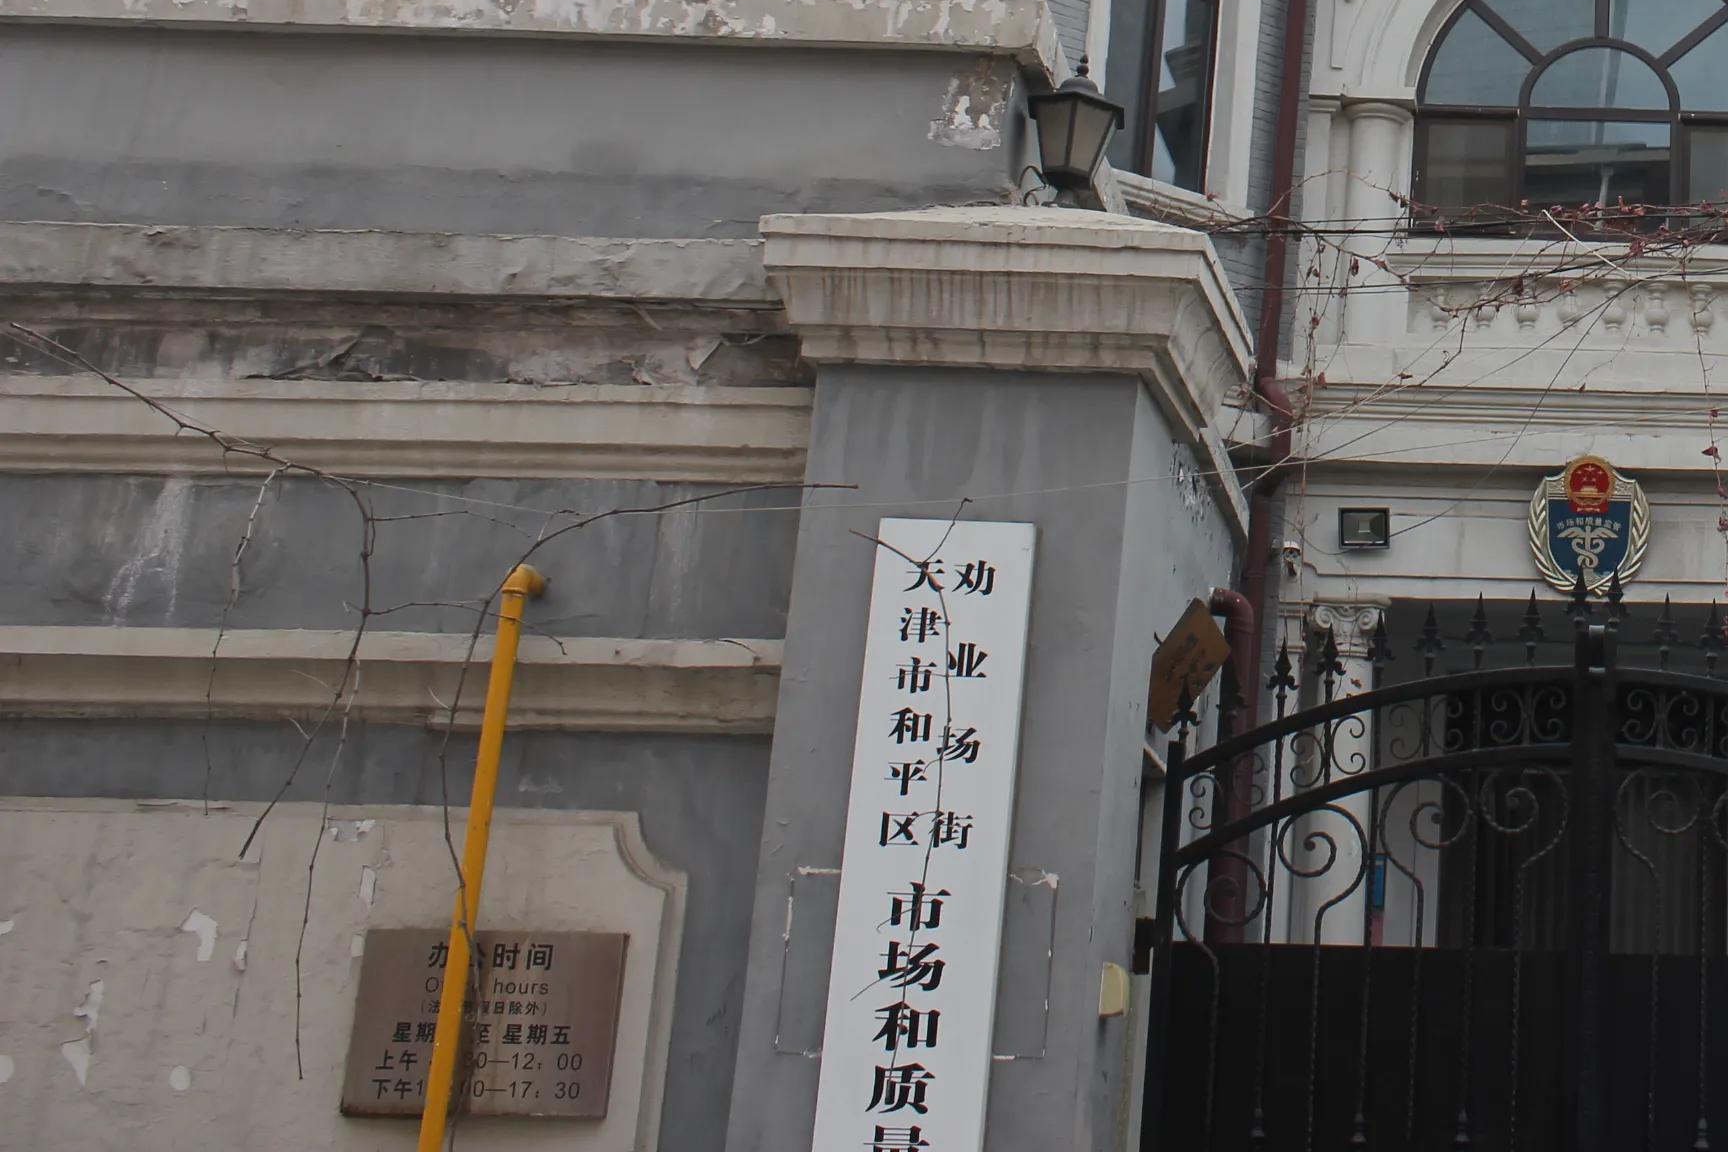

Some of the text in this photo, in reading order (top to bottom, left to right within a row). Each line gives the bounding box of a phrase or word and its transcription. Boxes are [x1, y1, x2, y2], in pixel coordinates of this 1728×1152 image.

[878, 560, 944, 847] 天津市和平区
[929, 559, 995, 849] 劝业场街
[392, 1021, 491, 1044] 星期至
[493, 979, 549, 995] hours
